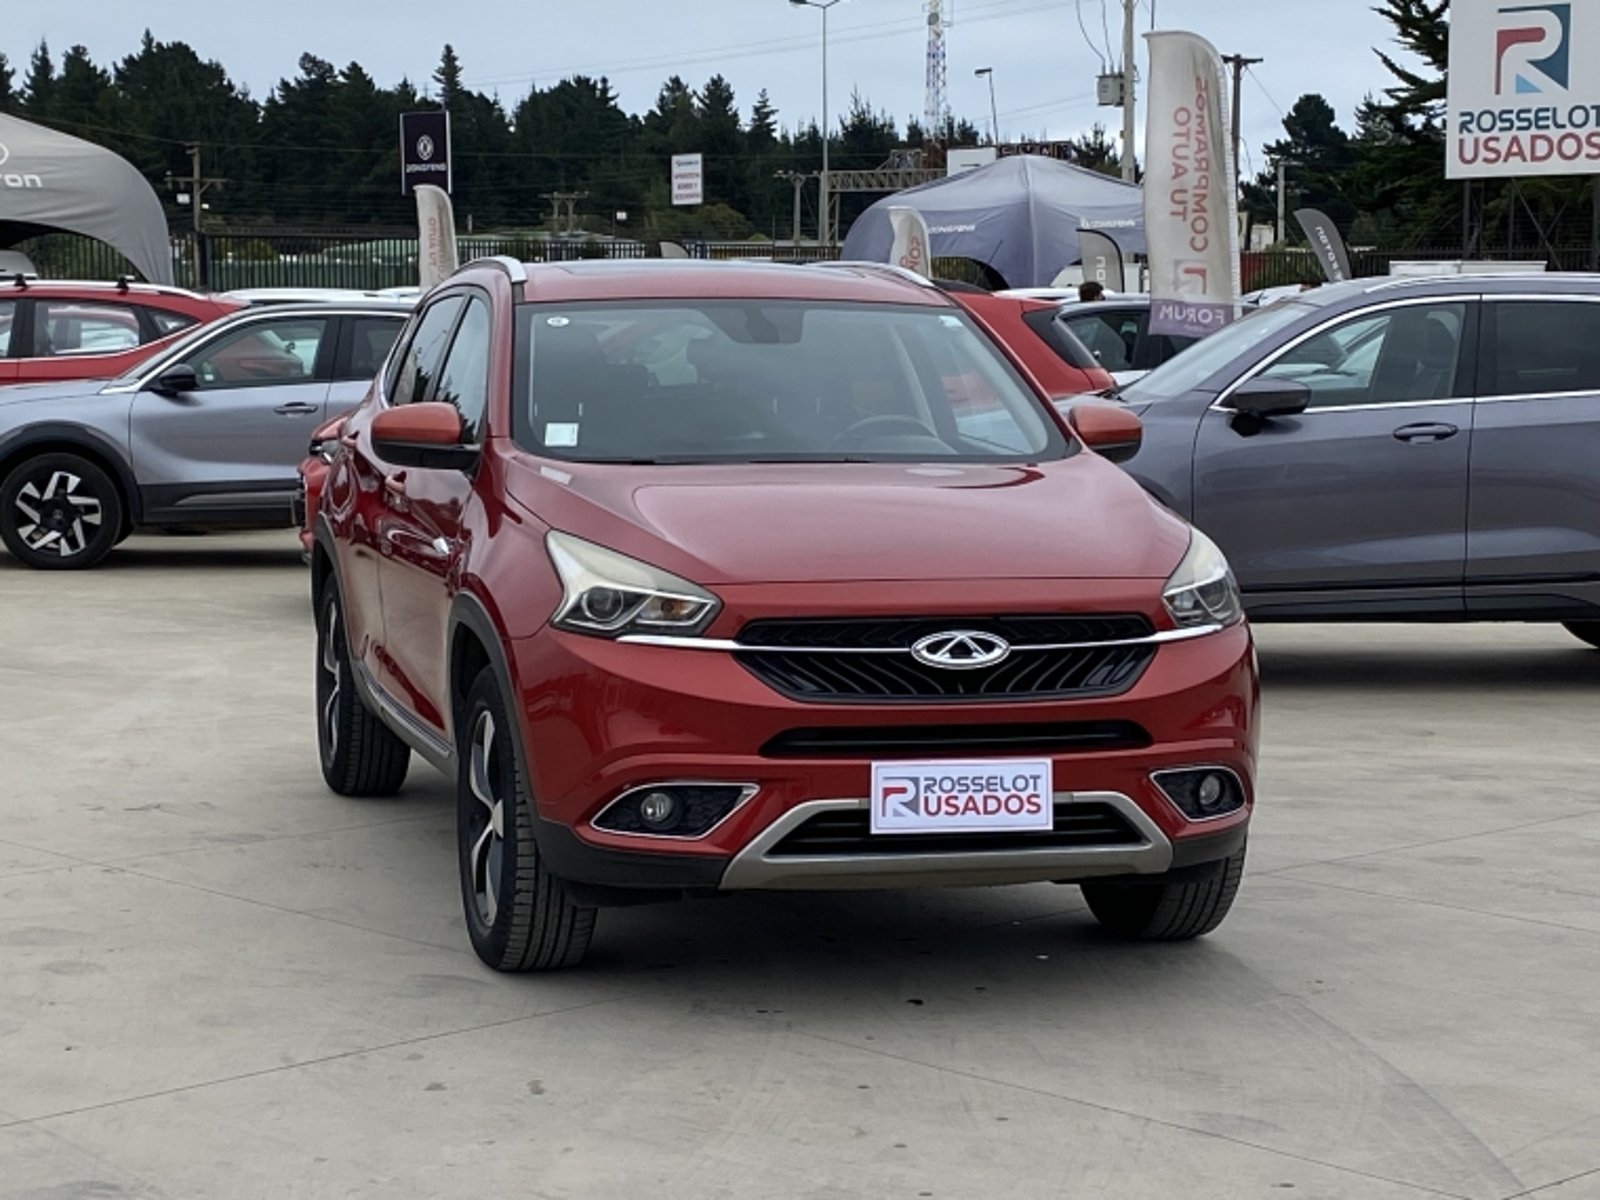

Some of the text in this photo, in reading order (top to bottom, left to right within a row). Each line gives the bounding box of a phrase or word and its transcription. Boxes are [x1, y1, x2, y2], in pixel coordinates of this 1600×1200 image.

[1458, 105, 1600, 134] ROSSELOT
[1458, 132, 1600, 164] USADOS
[924, 775, 1041, 794] ROSSELOT
[924, 794, 1042, 816] USADOS
